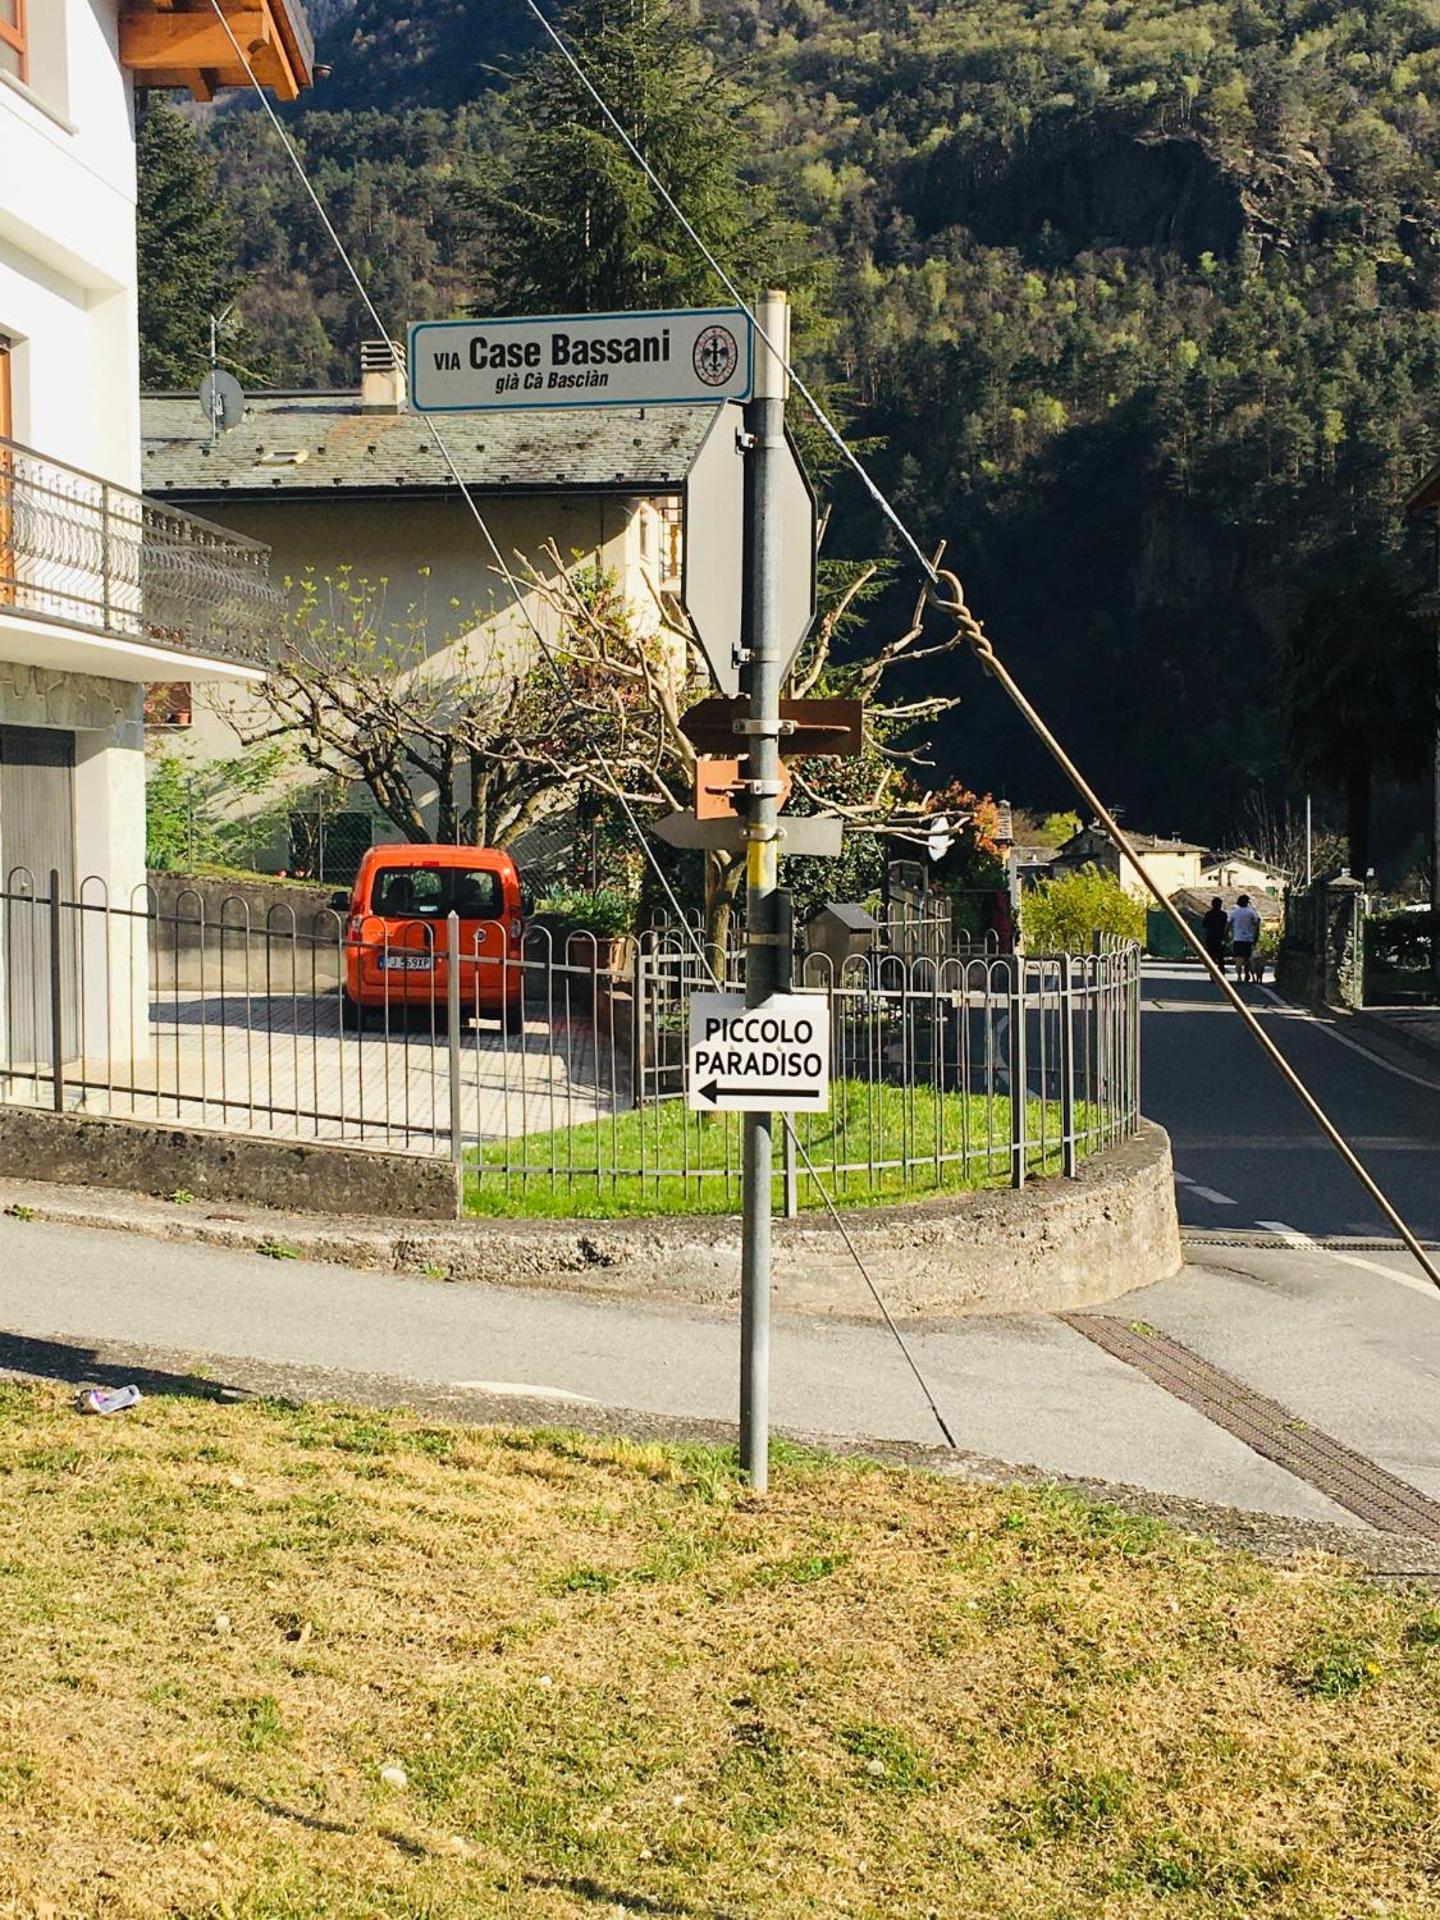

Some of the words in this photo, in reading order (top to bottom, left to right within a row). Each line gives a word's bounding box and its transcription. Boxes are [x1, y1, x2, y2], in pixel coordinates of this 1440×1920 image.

[434, 352, 461, 370] VIA
[469, 337, 541, 369] Case
[551, 328, 670, 365] Bassani
[495, 372, 520, 394] già
[523, 372, 544, 389] Cà
[547, 370, 609, 389] Basciàn
[705, 1018, 813, 1044] PICCOLO
[695, 1051, 823, 1077] PARADISO
